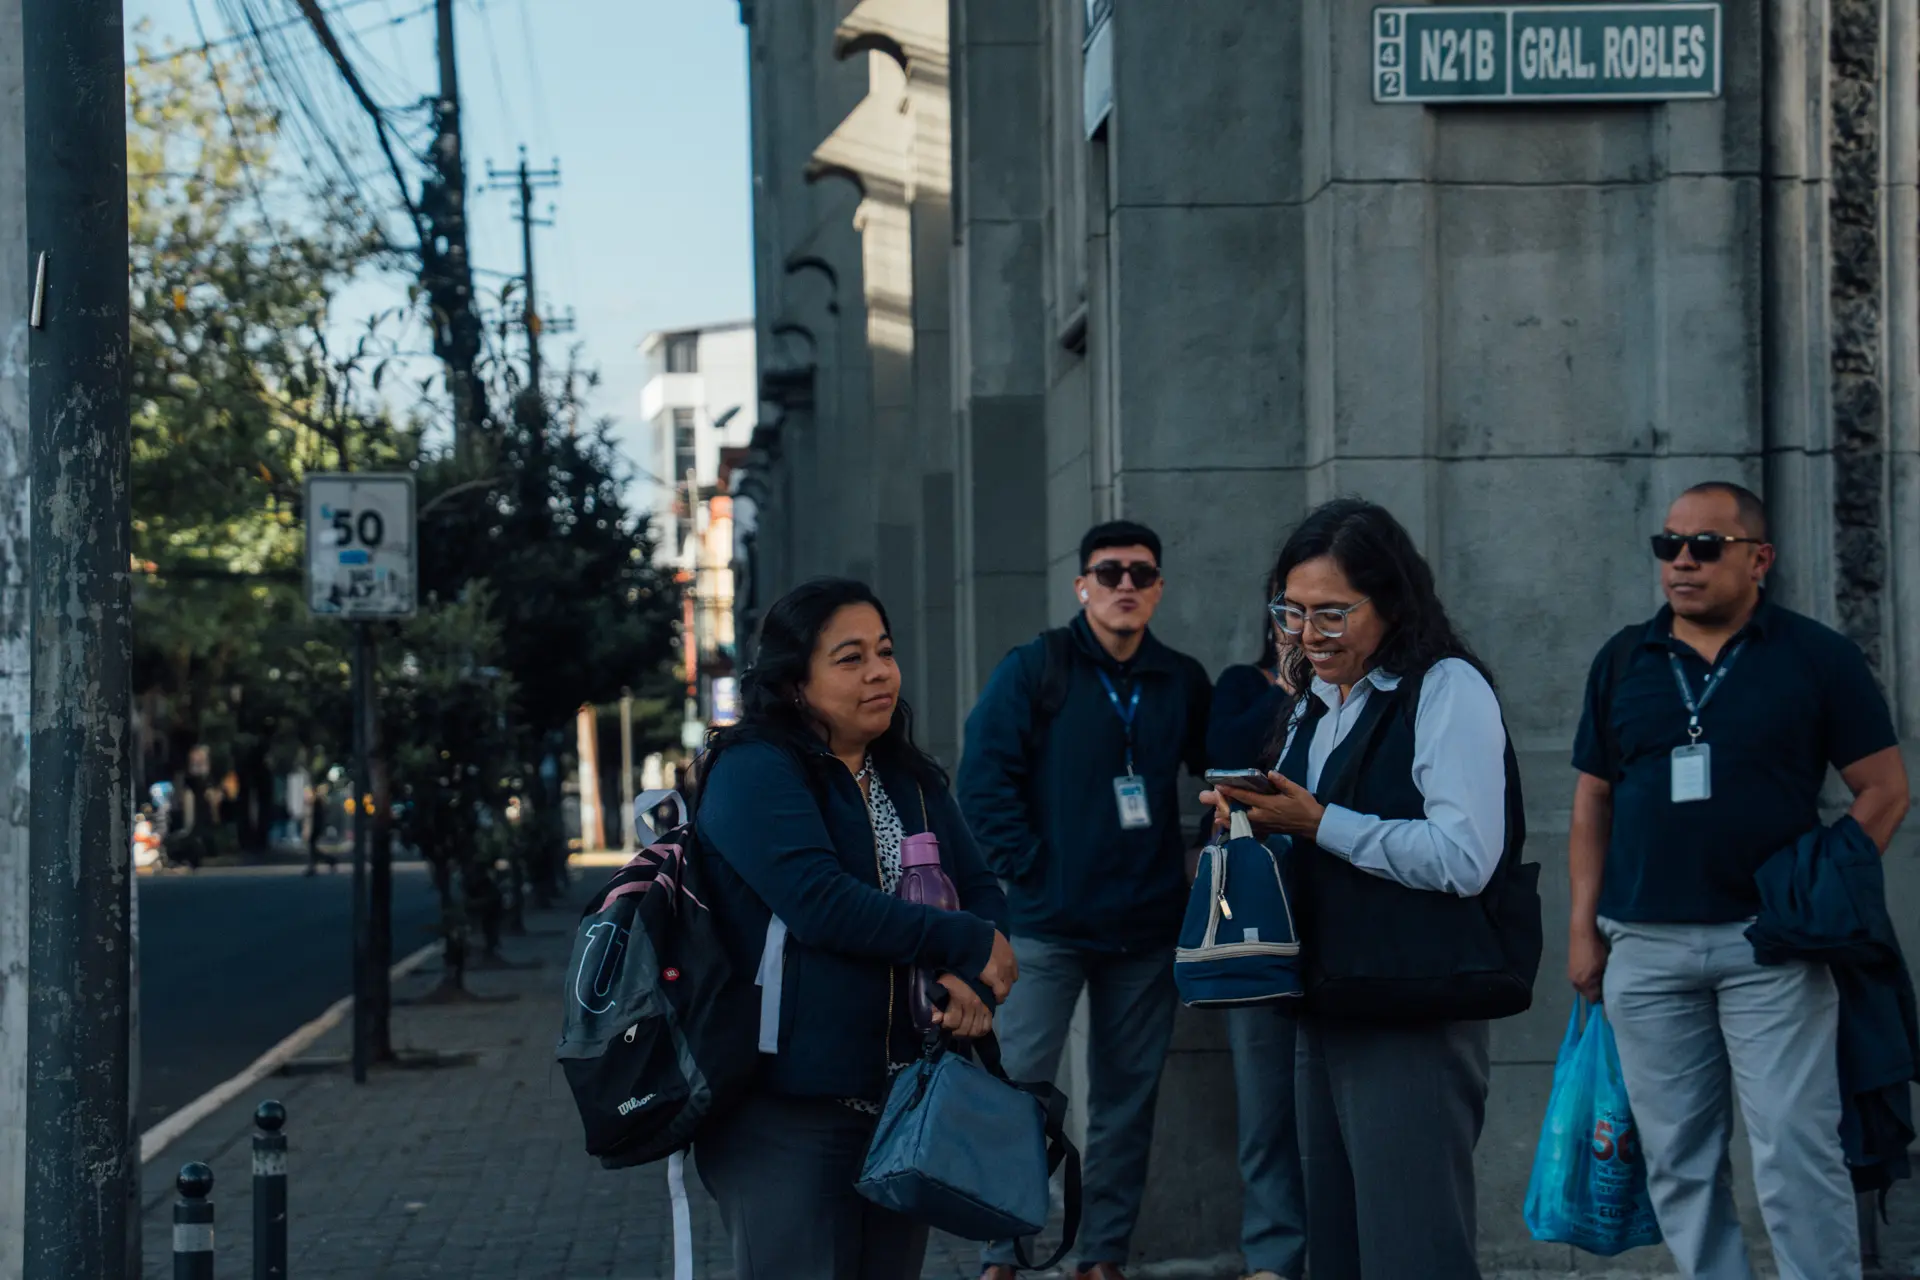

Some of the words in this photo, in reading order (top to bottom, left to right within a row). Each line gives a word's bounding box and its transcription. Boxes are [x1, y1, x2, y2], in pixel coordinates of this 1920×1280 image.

[1420, 29, 1495, 82] N21B
[1519, 26, 1596, 80] GRAL.
[1603, 25, 1706, 79] ROBLES
[332, 508, 385, 547] 50
[617, 1093, 657, 1116] Wilson
